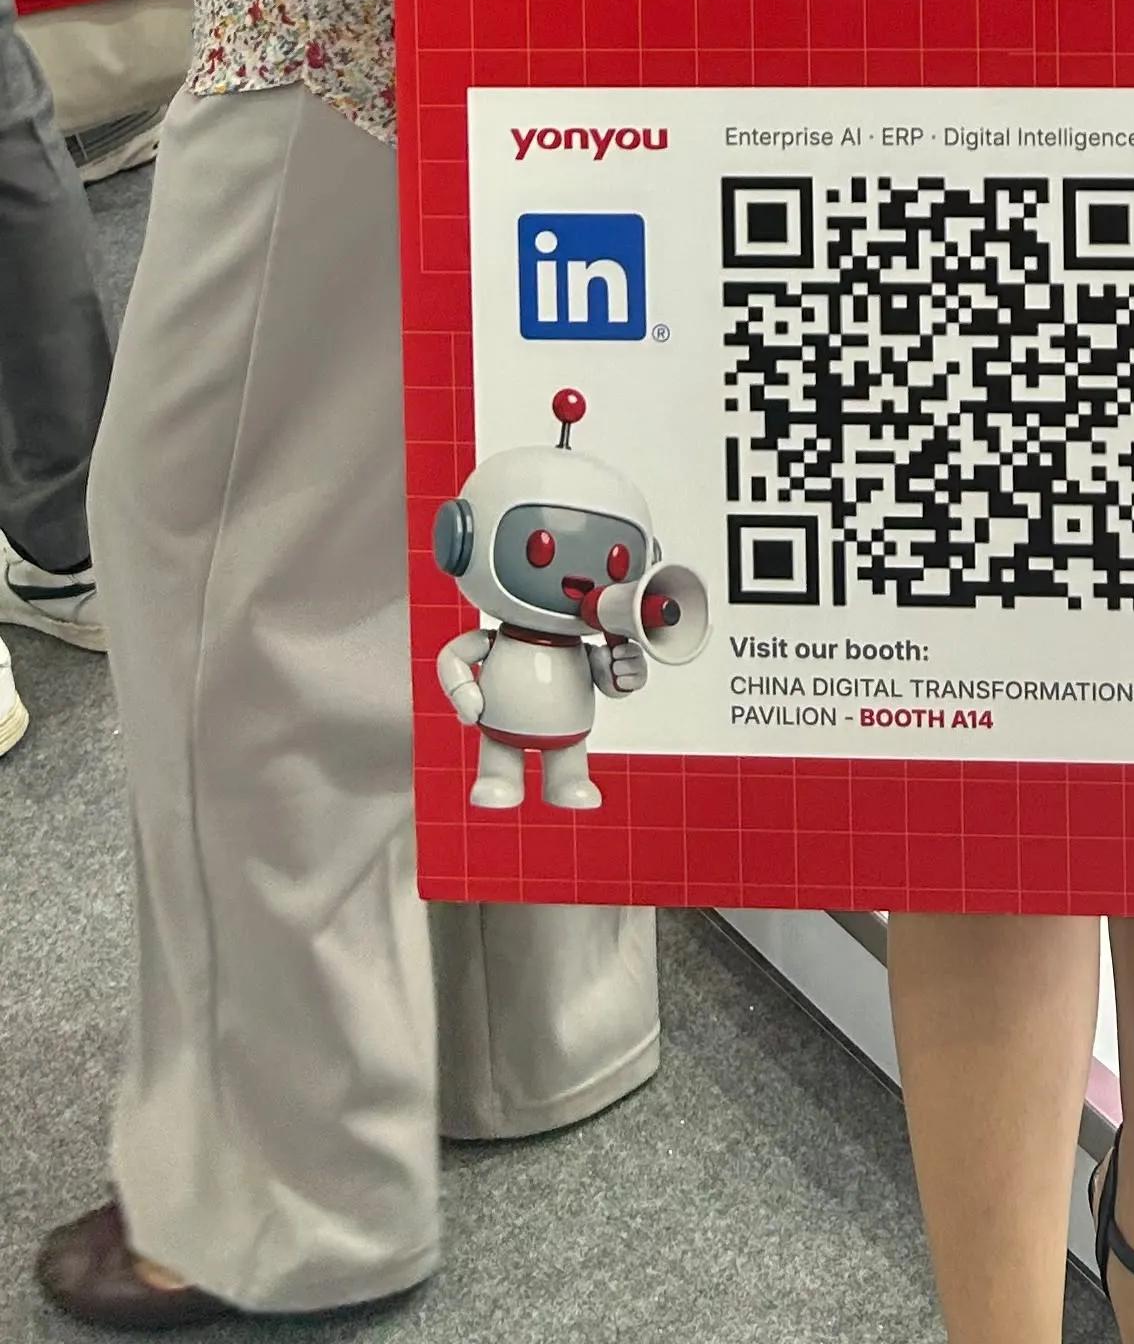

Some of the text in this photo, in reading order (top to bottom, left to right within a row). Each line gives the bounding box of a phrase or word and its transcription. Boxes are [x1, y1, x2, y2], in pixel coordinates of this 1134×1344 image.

[510, 125, 668, 161] yonyou
[725, 125, 834, 152] Enterprise
[839, 126, 862, 148] AI
[881, 126, 924, 148] ERP
[944, 125, 1011, 153] Digital
[535, 230, 631, 324] in
[729, 635, 930, 662] Visit our booth:
[730, 675, 1134, 703] CHINA DIGITAL TRANSFORMATION
[731, 705, 838, 727] PAVILION
[859, 707, 946, 730] BOOTH
[951, 708, 995, 730] A14
